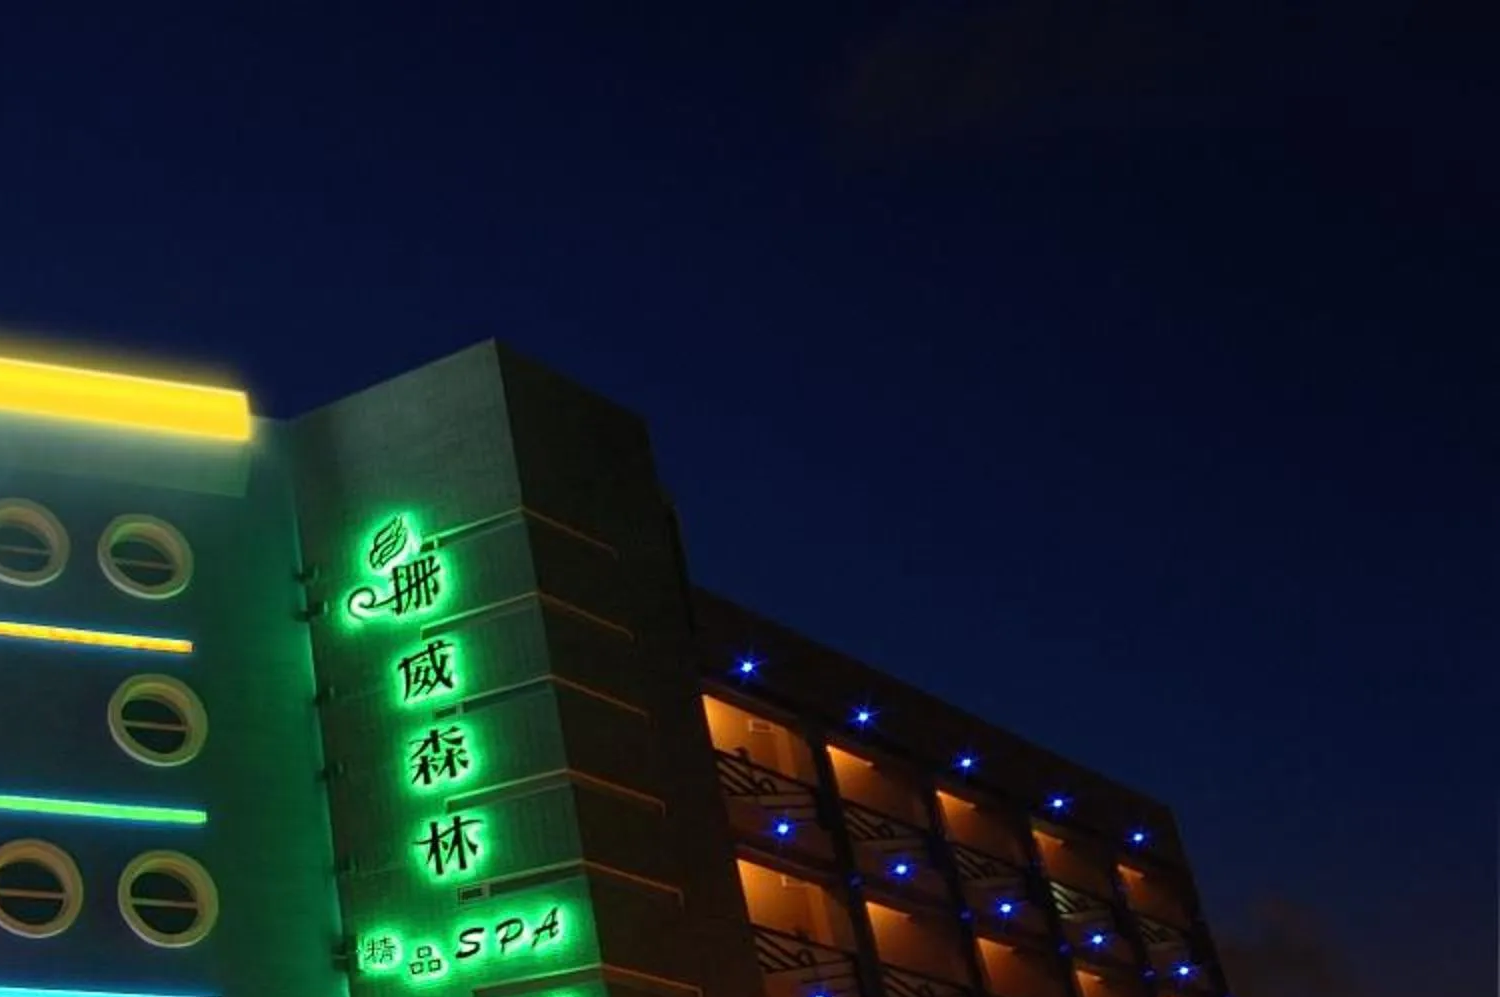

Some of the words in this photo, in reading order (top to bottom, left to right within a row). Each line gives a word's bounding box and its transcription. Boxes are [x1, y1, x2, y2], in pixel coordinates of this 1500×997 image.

[348, 555, 484, 876] 挪威森林
[364, 937, 442, 975] 精品
[455, 907, 559, 958] SPA
